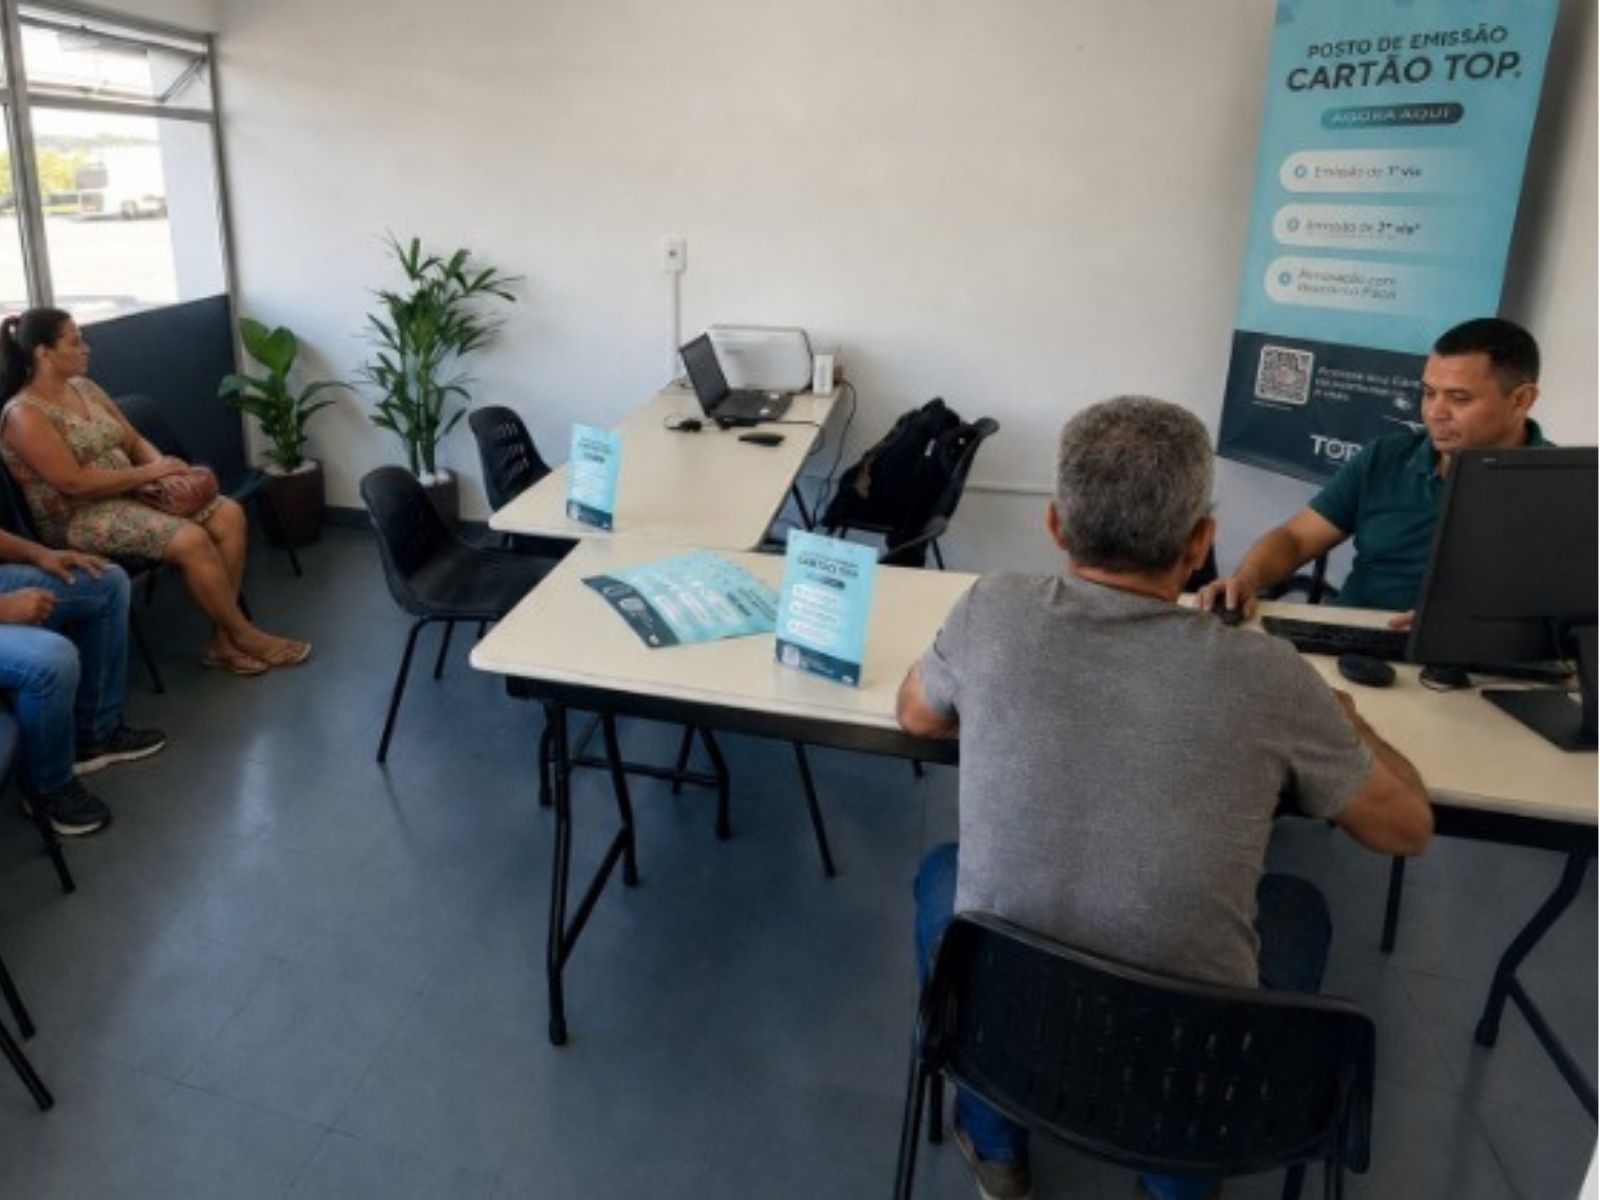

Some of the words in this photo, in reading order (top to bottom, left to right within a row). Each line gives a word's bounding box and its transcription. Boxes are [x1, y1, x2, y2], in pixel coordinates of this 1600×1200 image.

[1307, 39, 1371, 58] POSTO
[1378, 36, 1403, 52] DE
[1410, 23, 1509, 49] EMISSÃO
[1286, 54, 1433, 92] CARTÃO
[1444, 51, 1522, 81] TOP.
[1331, 109, 1397, 122] AGORA
[1401, 108, 1450, 120] AQUI
